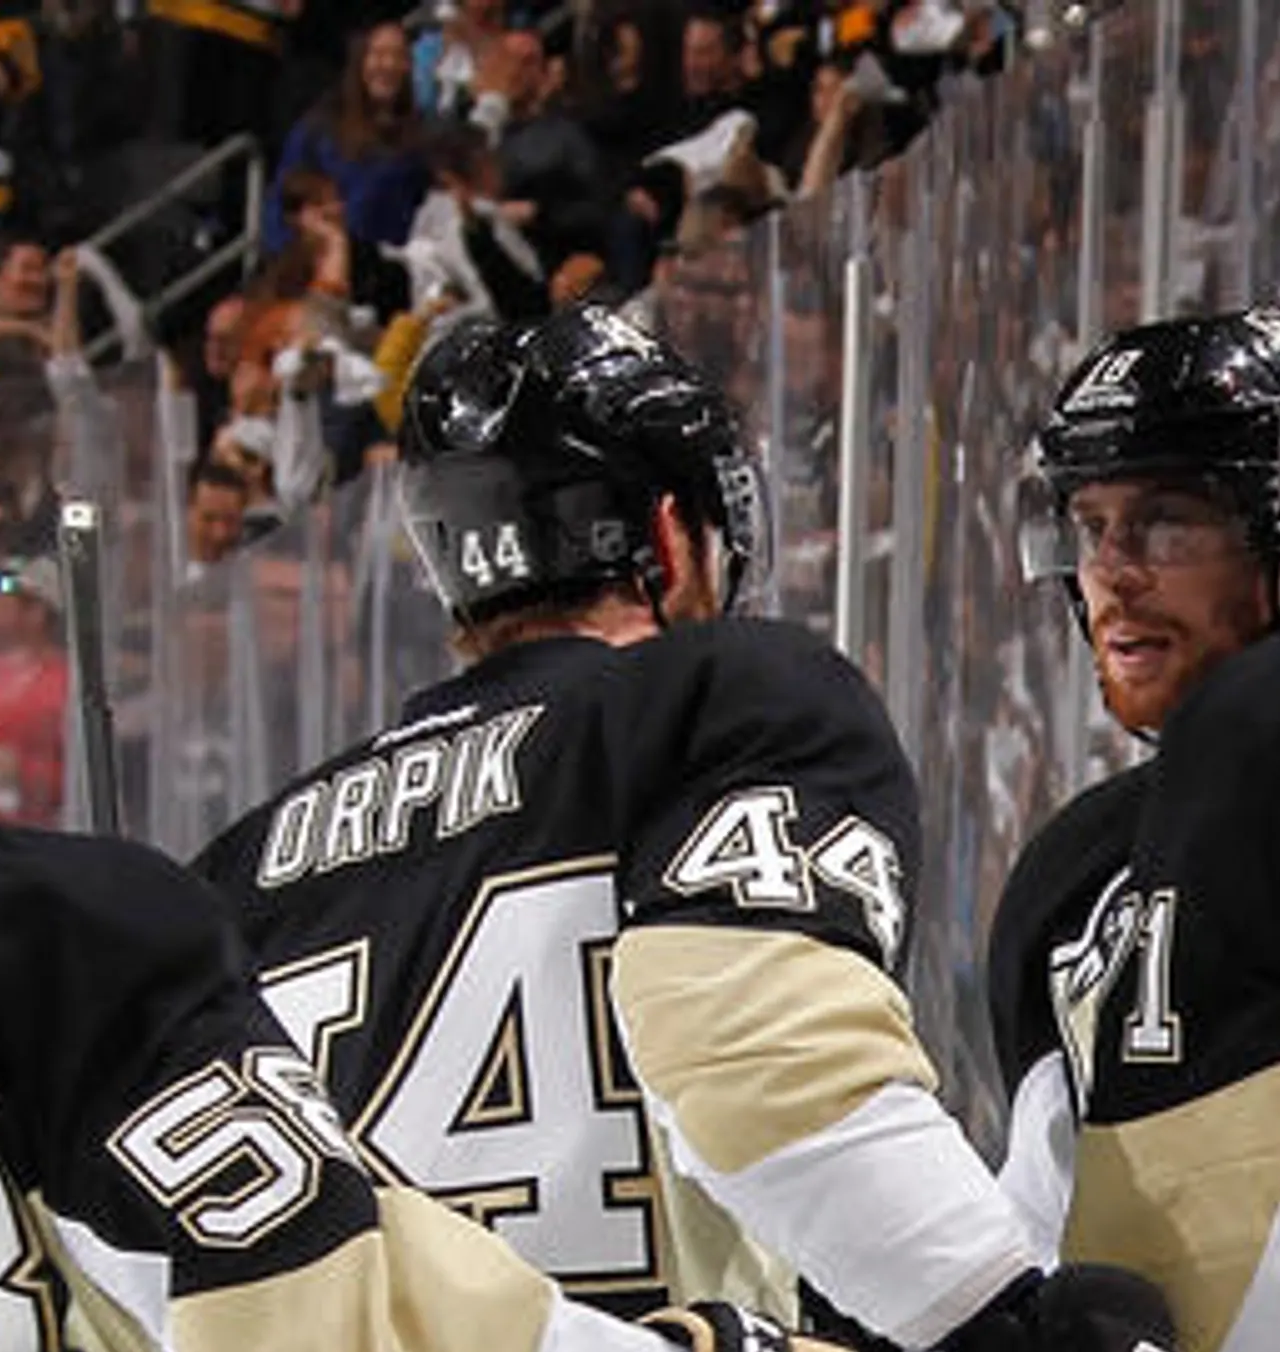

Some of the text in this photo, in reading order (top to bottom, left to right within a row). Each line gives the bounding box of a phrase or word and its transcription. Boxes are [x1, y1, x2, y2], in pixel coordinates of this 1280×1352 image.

[460, 523, 530, 586] 44
[257, 704, 547, 888] ORPIK
[661, 785, 906, 972] 44
[258, 853, 668, 1296] 4
